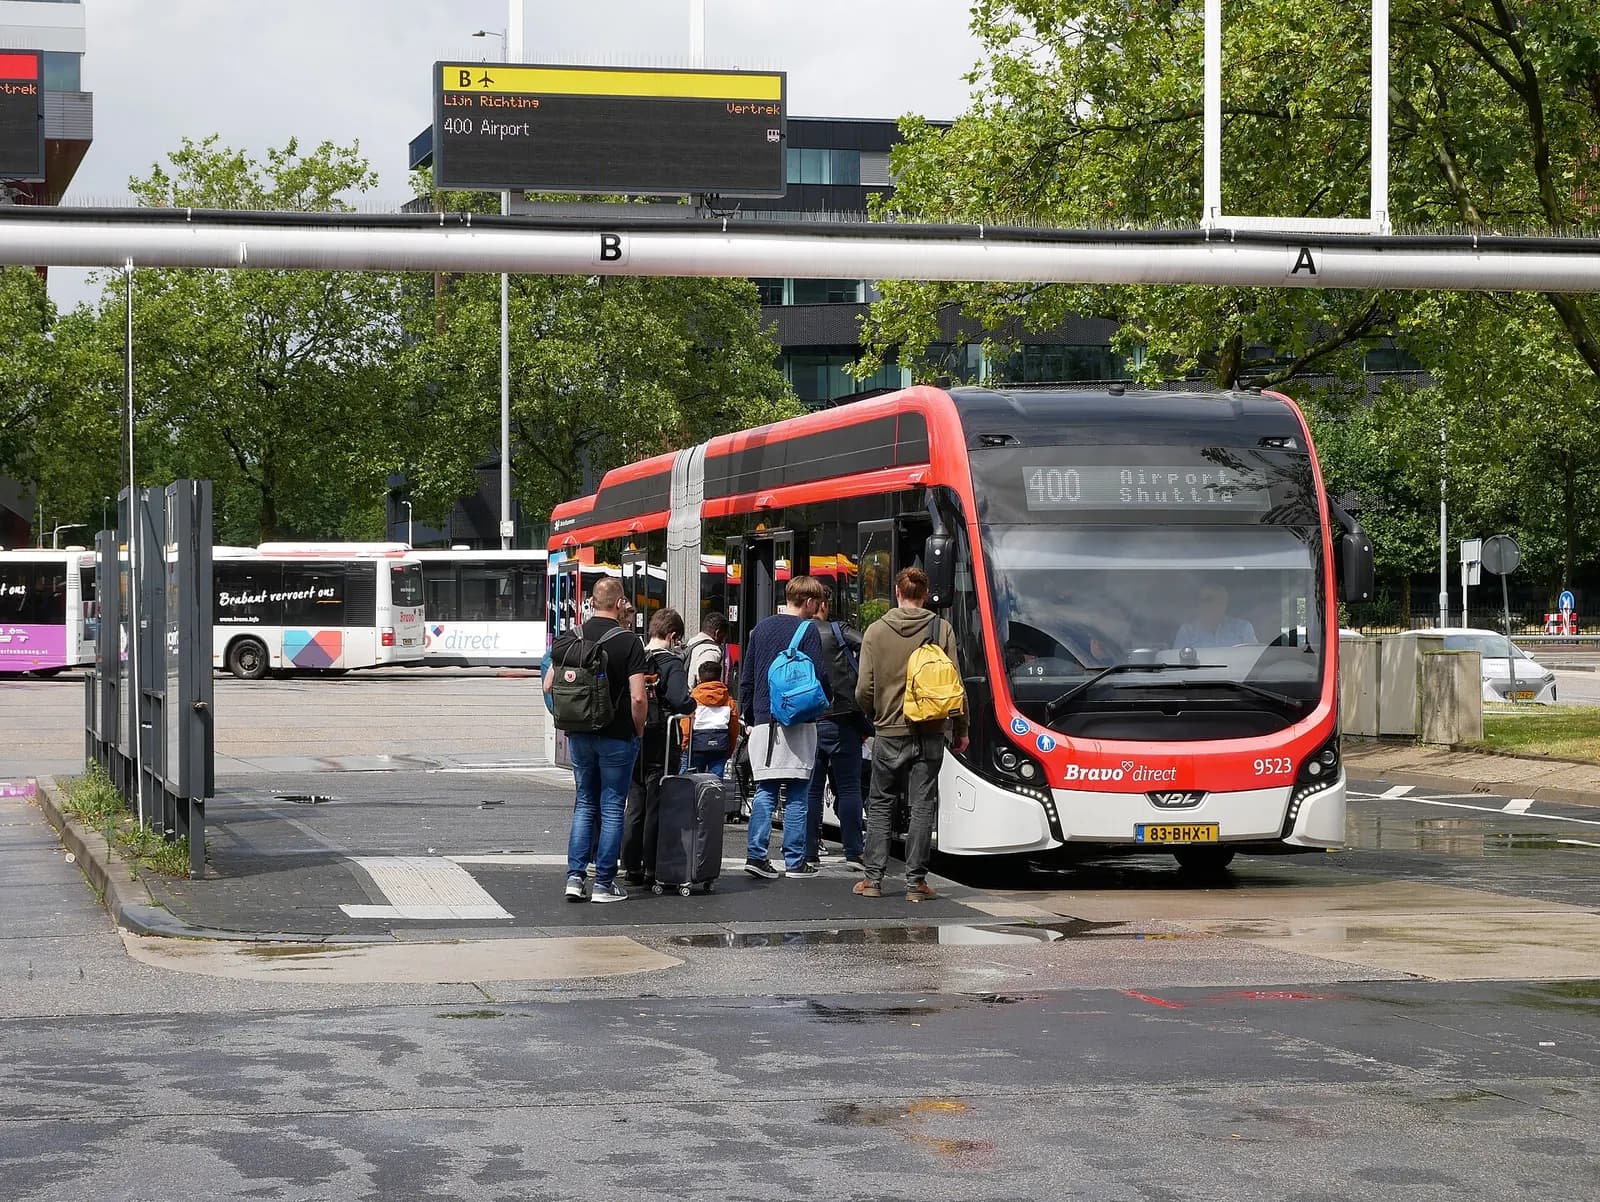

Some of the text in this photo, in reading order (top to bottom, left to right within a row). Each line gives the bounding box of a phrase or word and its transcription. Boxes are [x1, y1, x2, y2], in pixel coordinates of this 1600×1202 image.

[459, 70, 472, 87] B
[444, 94, 541, 108] Lijn Richting
[726, 103, 781, 115] Vertrek
[444, 117, 530, 140] 400 Airport
[600, 233, 622, 261] B
[1291, 247, 1317, 274] A
[1029, 468, 1231, 502] 400 Airport
[1119, 486, 1233, 503] Shuttle
[219, 585, 335, 607] Brabant vervoert ons
[445, 629, 500, 650] direct
[1063, 764, 1177, 782] Bravo direct
[1253, 757, 1293, 776] 9523
[1154, 793, 1198, 805] VDL
[1150, 827, 1211, 841] 83-BHX-1
